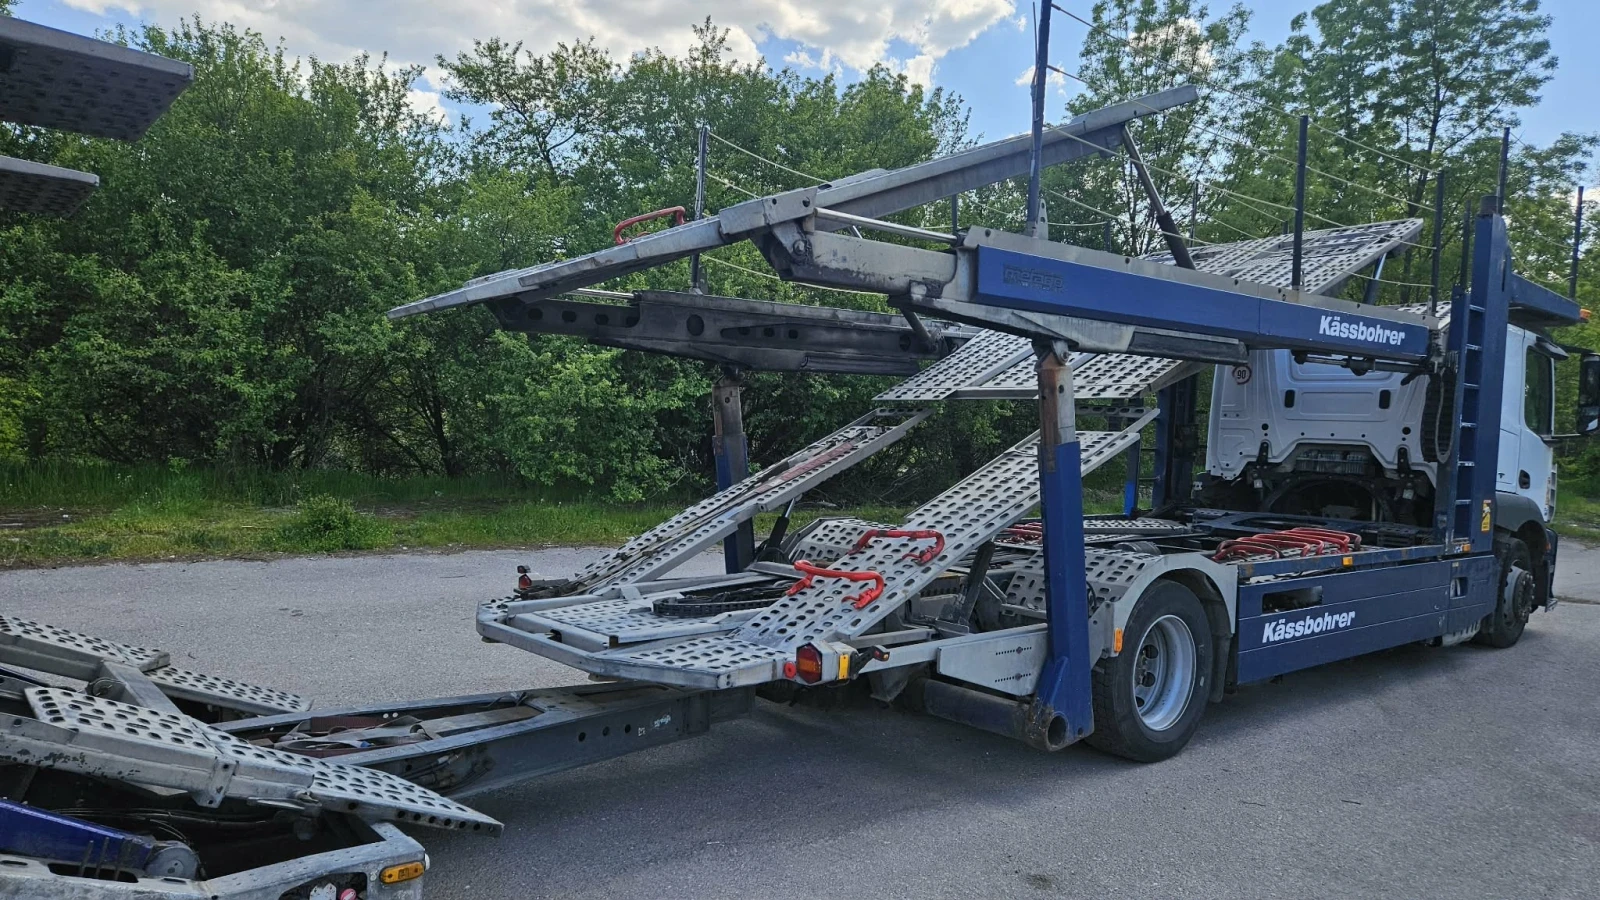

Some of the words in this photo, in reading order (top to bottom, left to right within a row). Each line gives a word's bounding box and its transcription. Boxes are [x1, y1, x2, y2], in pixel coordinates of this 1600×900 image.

[1319, 315, 1405, 346] Kässbohrer
[1237, 369, 1247, 380] 90
[1262, 611, 1356, 643] Kässbohrer
